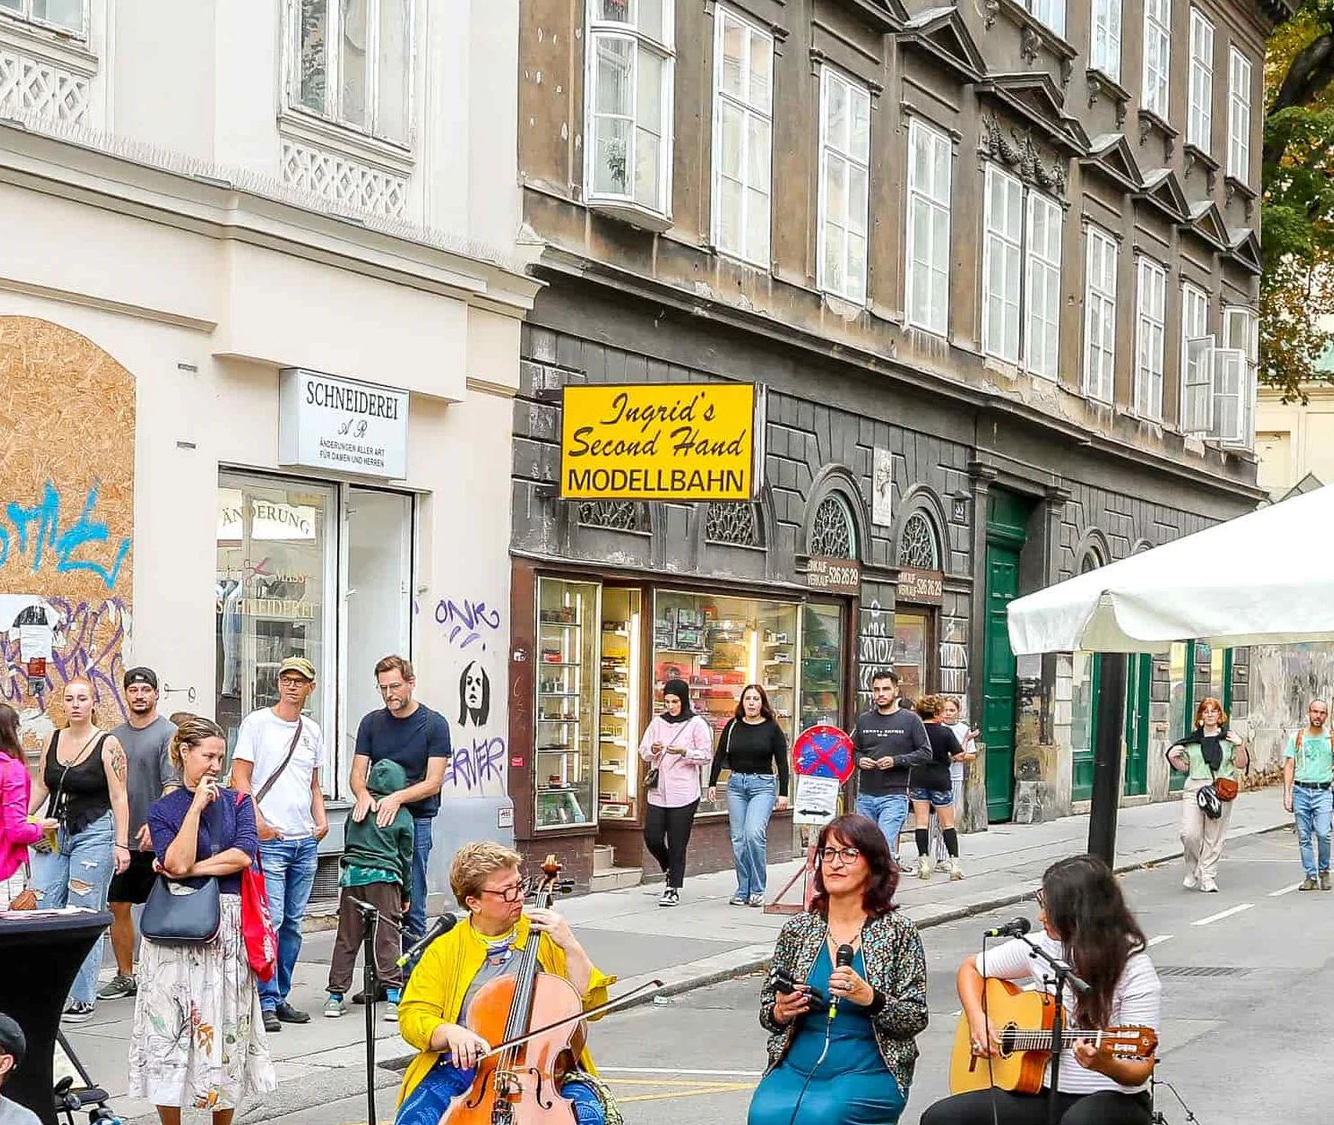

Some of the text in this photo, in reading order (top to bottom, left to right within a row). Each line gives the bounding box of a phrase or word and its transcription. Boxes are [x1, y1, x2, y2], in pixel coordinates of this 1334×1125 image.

[306, 381, 398, 420] SCHNEIDEREI
[600, 391, 716, 432] Ingrid's
[568, 426, 747, 457] Second Hand
[332, 451, 350, 462] DAMEN
[351, 455, 363, 464] UND
[568, 469, 744, 491] MODELLBAHN
